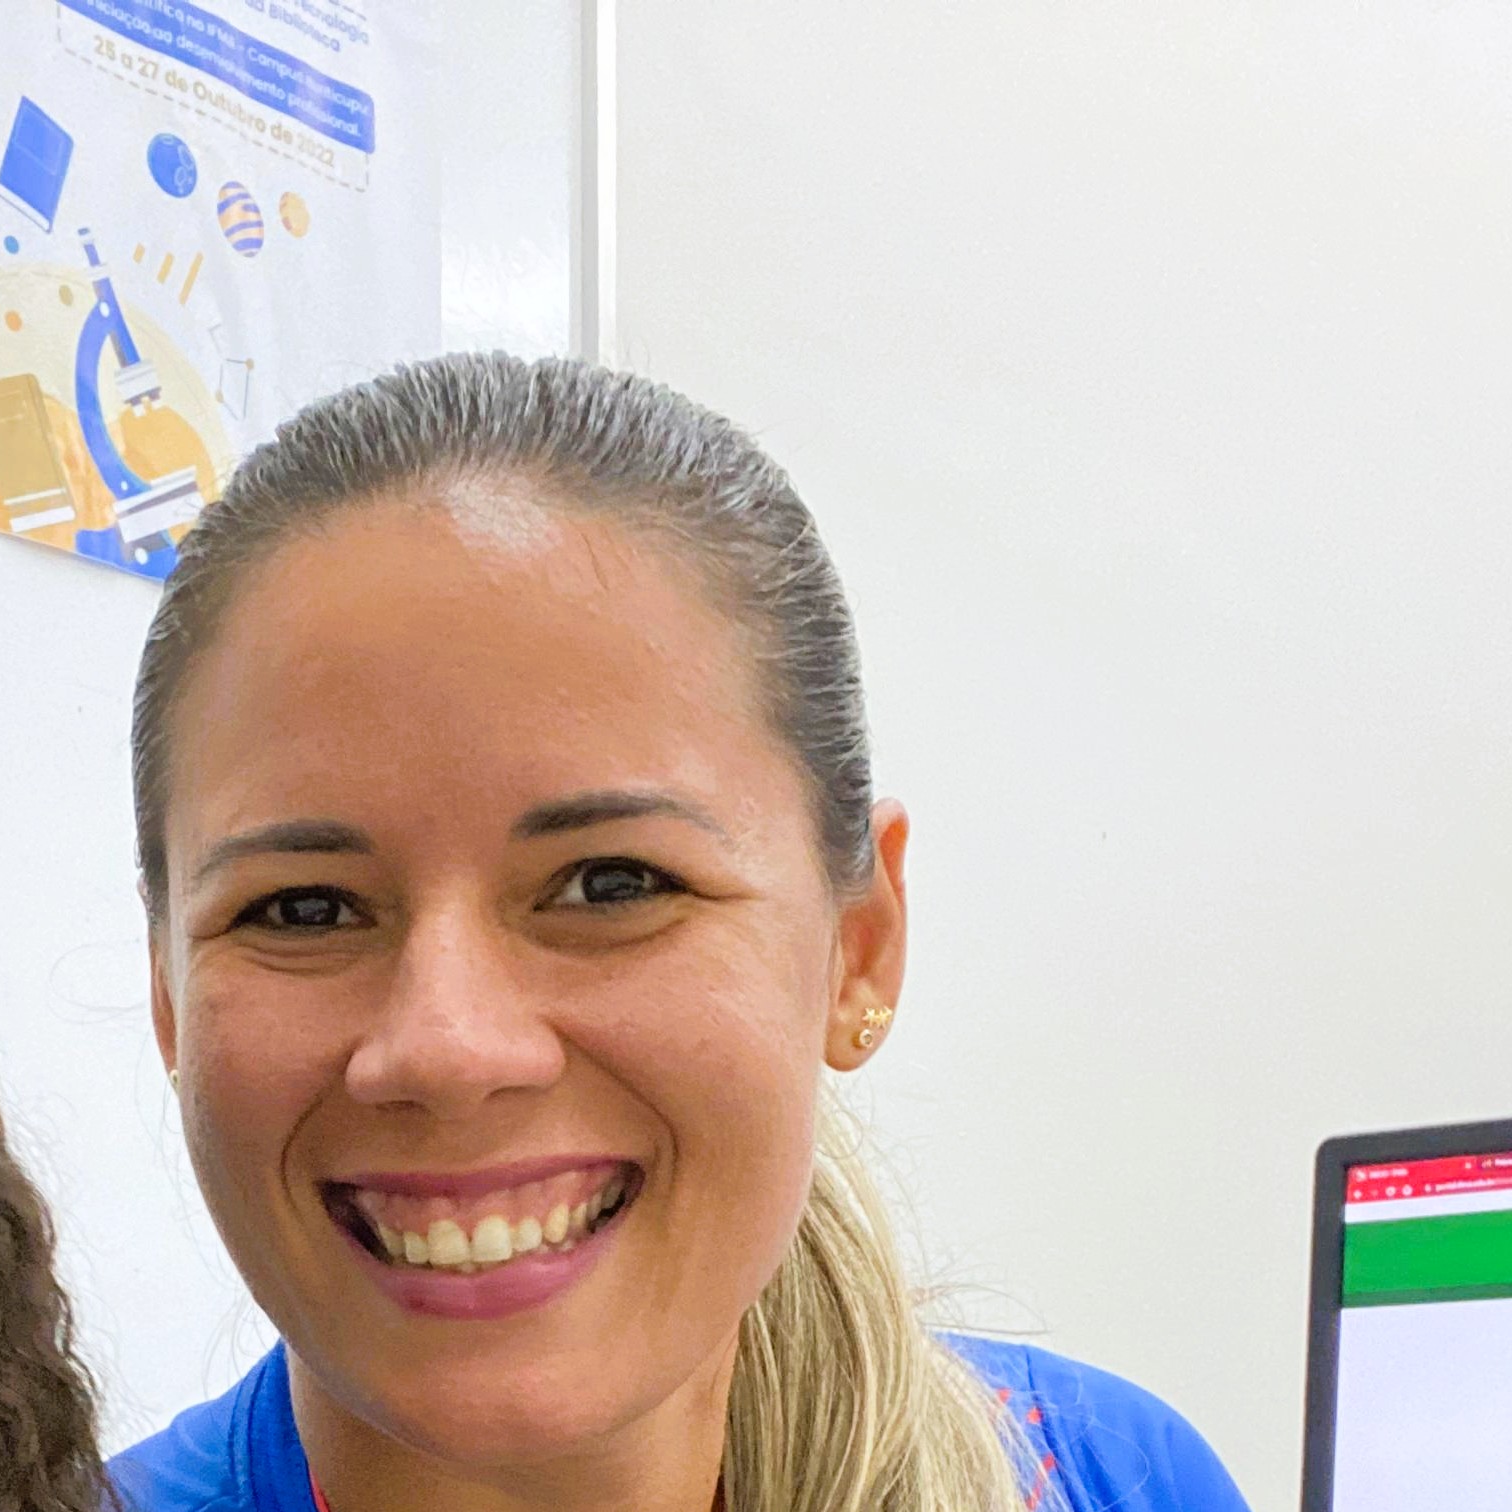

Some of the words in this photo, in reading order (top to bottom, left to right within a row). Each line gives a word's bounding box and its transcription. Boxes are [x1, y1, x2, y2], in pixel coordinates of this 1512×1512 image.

[93, 34, 116, 60] 25
[121, 53, 133, 70] a
[137, 56, 160, 80] 27
[165, 69, 188, 93] de
[192, 80, 266, 133] Outubro
[270, 121, 293, 145] de
[176, 33, 286, 100] desenvolvimento
[248, 46, 304, 83] Campus
